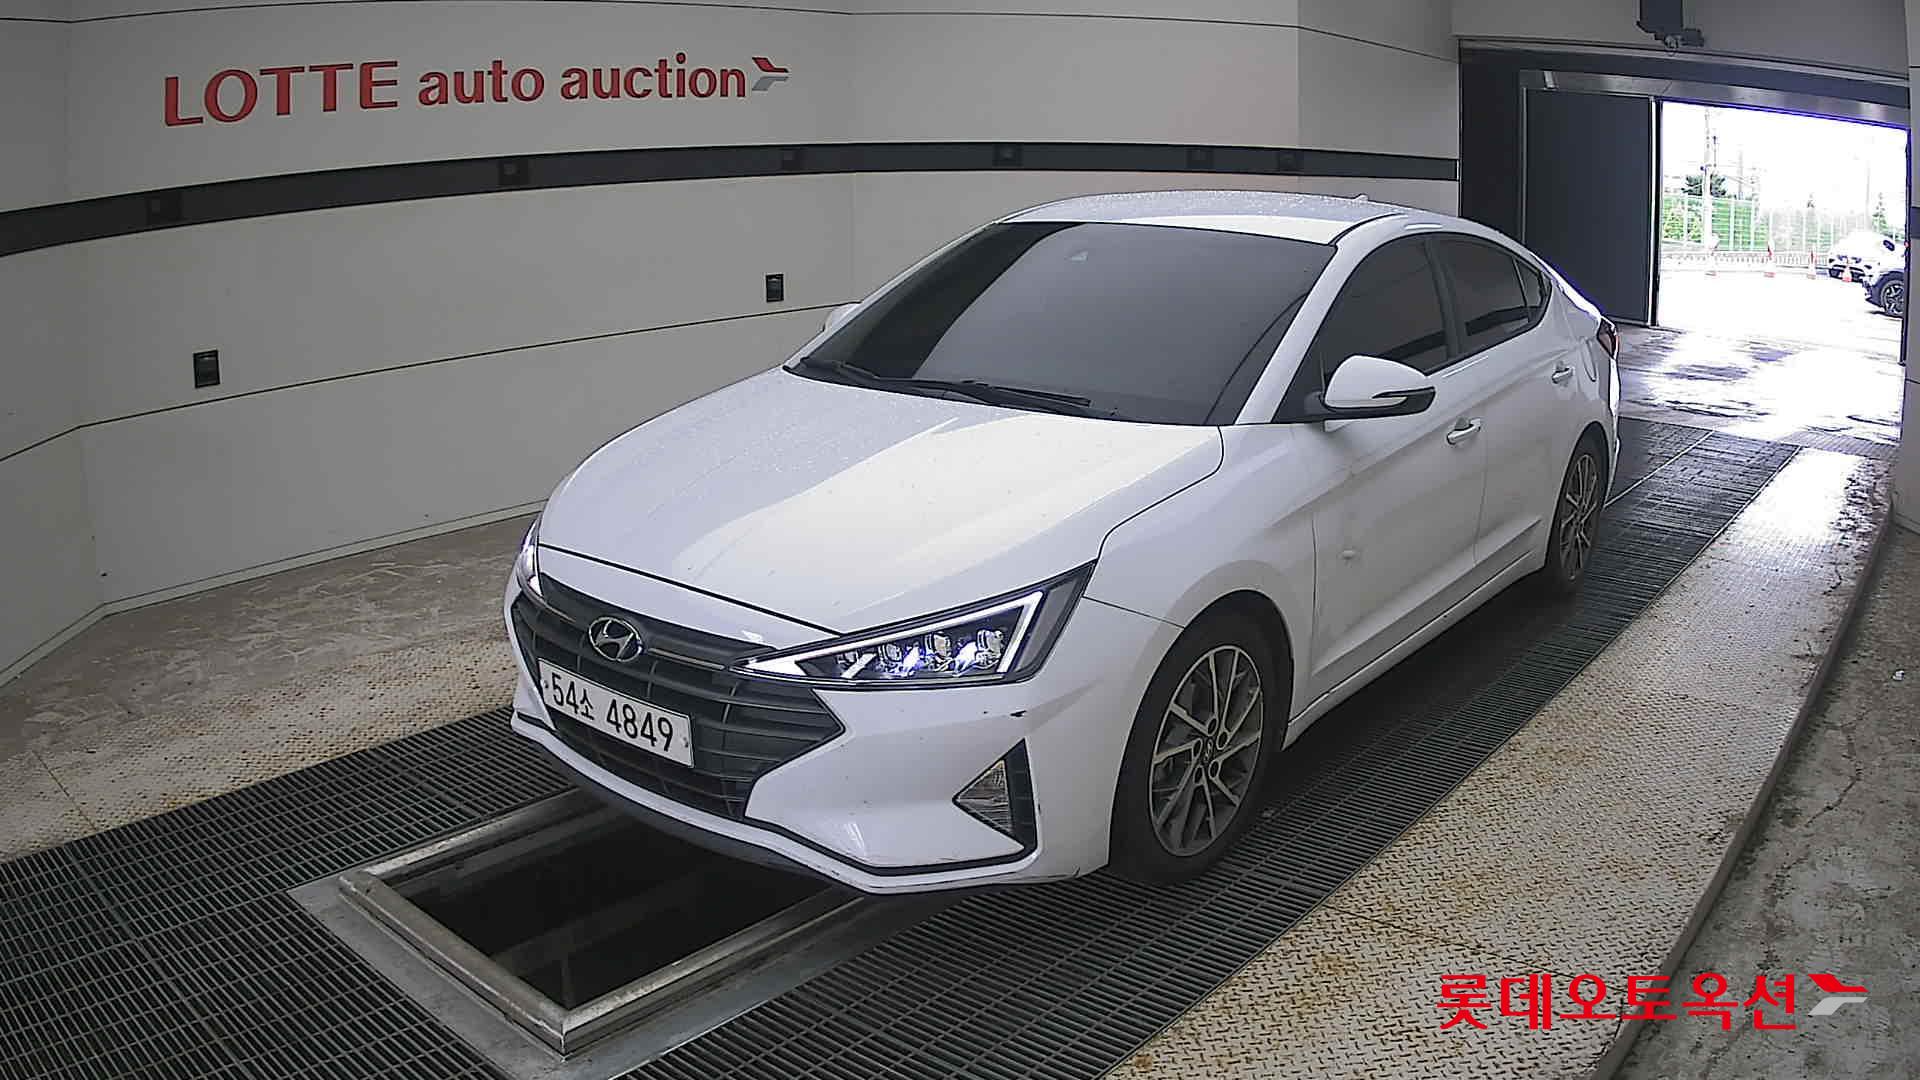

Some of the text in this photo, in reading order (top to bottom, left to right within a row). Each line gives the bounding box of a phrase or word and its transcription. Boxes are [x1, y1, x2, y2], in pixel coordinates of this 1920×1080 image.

[164, 52, 747, 126] LOTTE auto auction
[551, 672, 674, 752] 54소 4849
